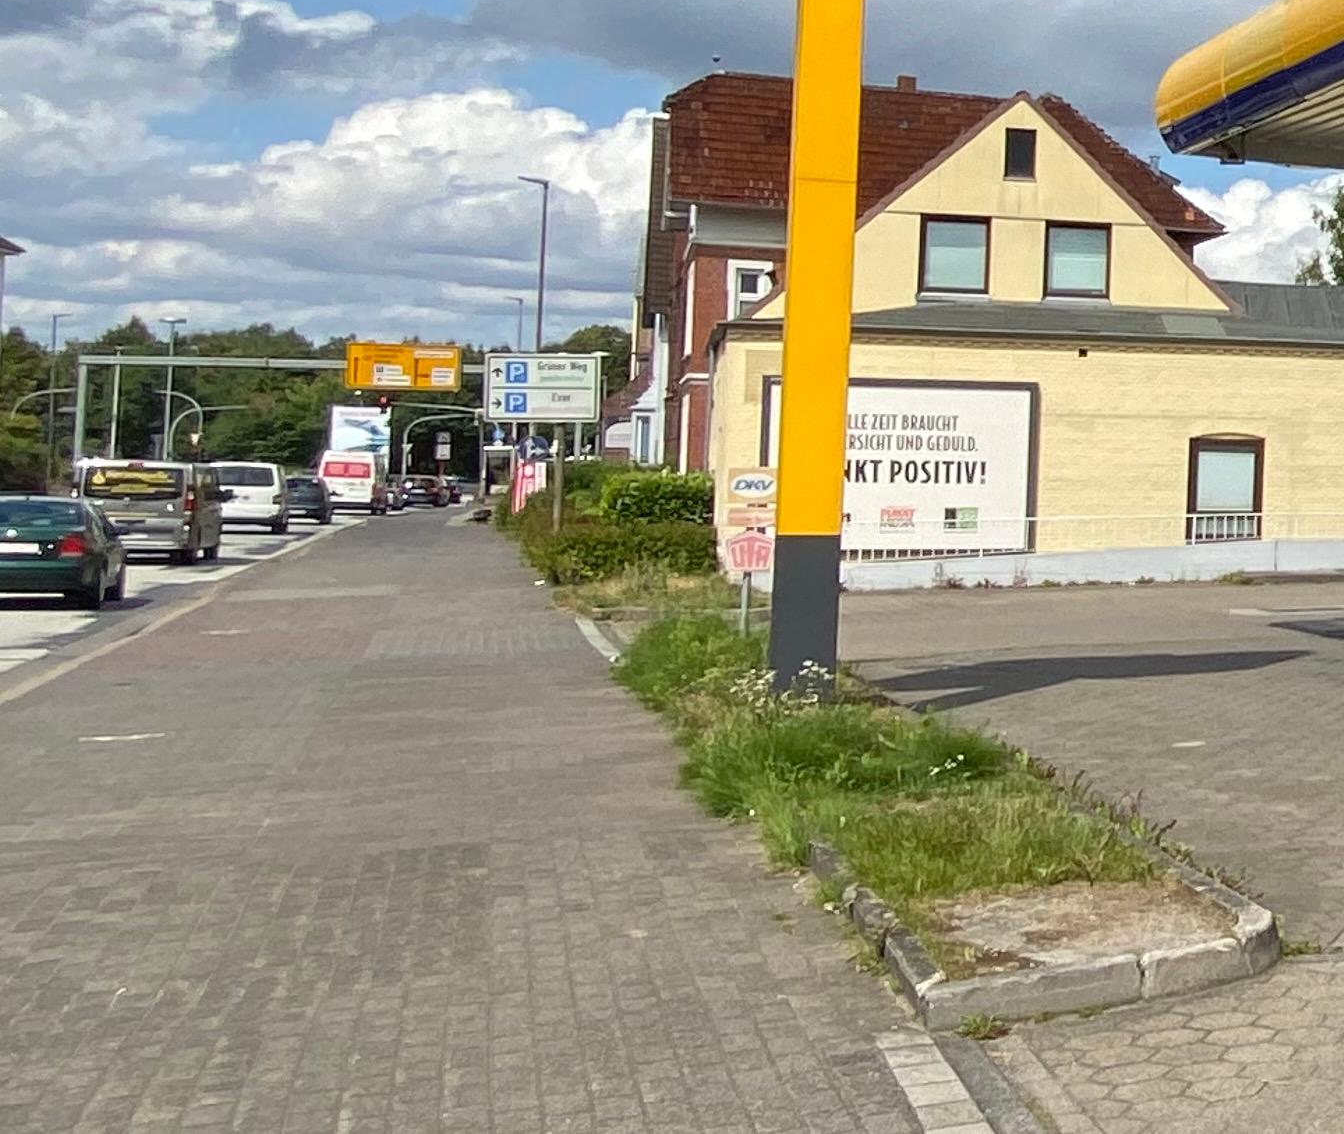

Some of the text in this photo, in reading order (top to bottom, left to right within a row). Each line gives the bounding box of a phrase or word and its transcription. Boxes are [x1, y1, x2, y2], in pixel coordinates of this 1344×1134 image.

[871, 413, 899, 430] ZEIT
[901, 414, 960, 432] BRAUCHT
[844, 433, 979, 452] RSICHT UND GEDULD.
[889, 460, 988, 485] POSITIV!
[733, 478, 774, 491] DKV
